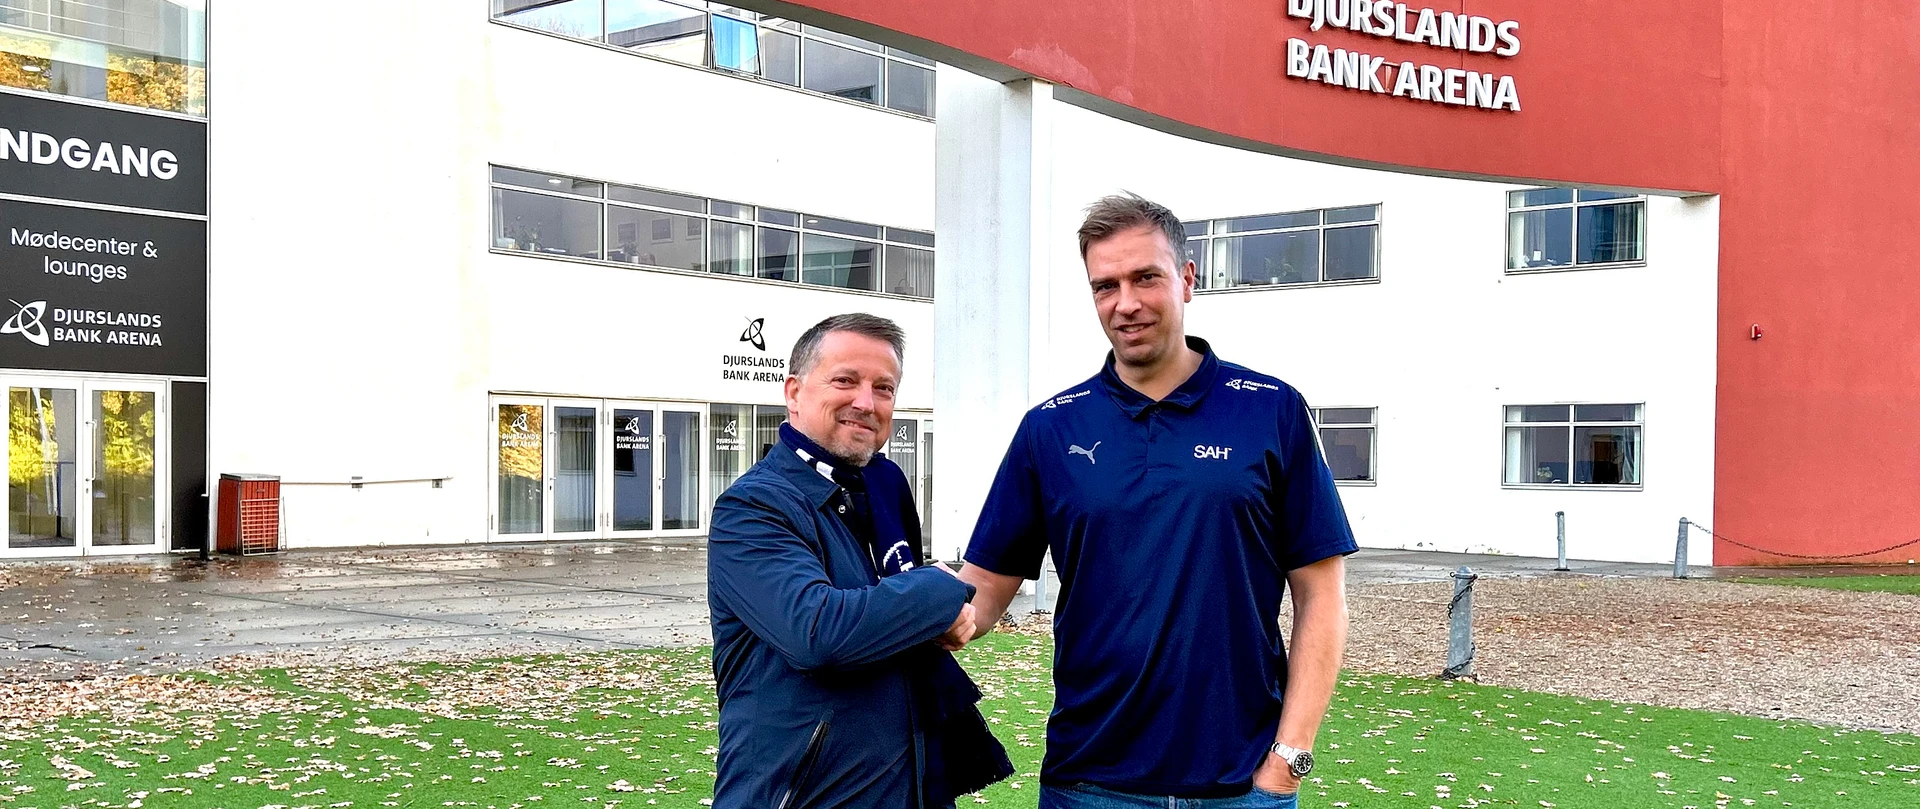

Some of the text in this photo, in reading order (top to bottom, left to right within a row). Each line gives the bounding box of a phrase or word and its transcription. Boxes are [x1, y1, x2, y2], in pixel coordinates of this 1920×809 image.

[1287, 37, 1521, 111] BANK ARENA
[0, 127, 179, 180] NDGANG
[11, 228, 158, 258] Mødecenter &
[44, 256, 128, 283] lounges
[53, 308, 162, 328] DJURSLANDS
[53, 327, 162, 347] BANK ARENA
[723, 354, 784, 369] DJURSLANDS
[723, 369, 784, 383] BANK ARENA
[616, 435, 650, 443] DJURSLANDS
